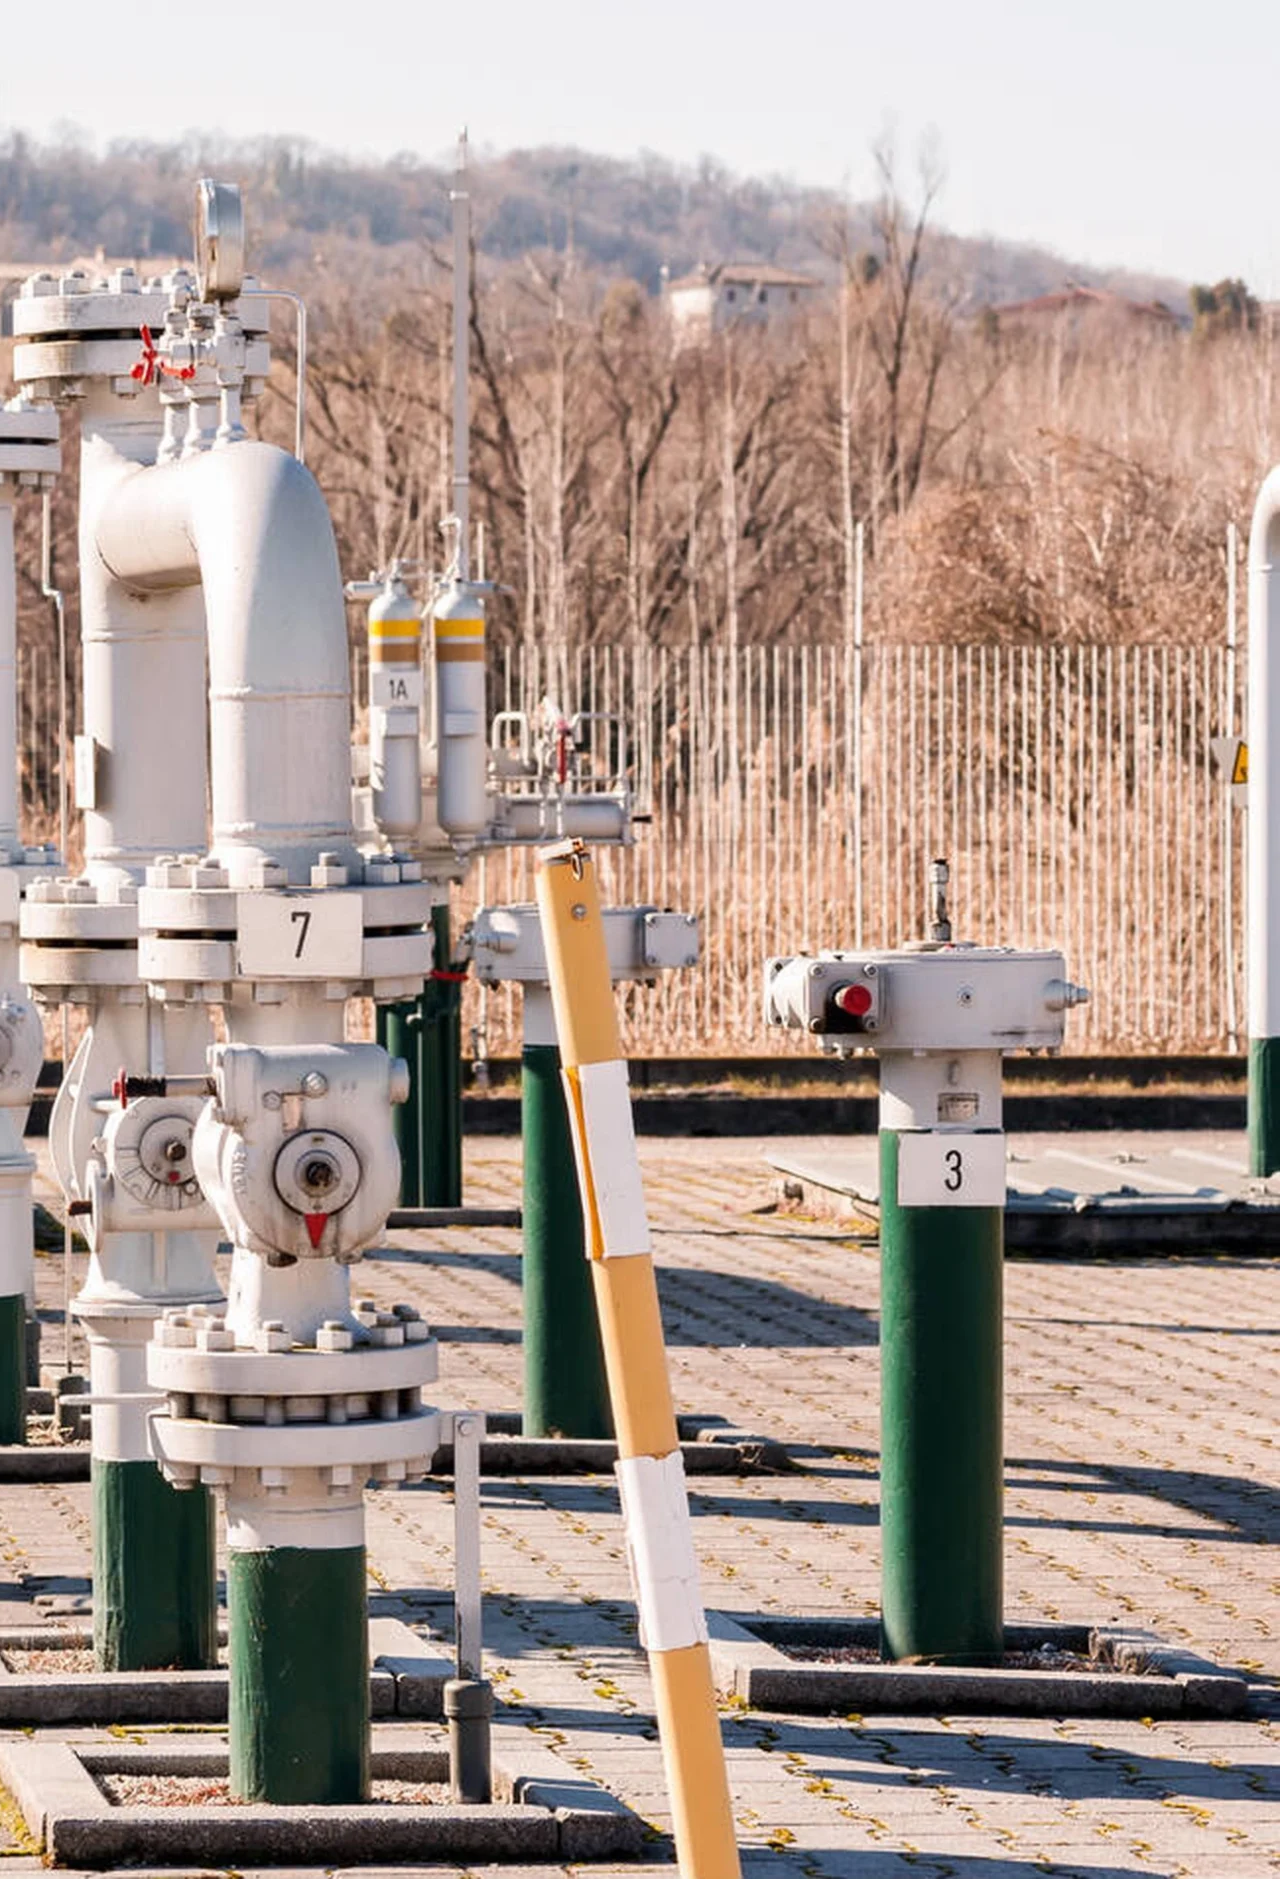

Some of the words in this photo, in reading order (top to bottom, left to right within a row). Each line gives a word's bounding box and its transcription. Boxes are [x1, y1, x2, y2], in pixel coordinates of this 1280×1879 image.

[388, 679, 409, 700] 1A
[291, 911, 312, 959] 7
[944, 1149, 962, 1192] 3
